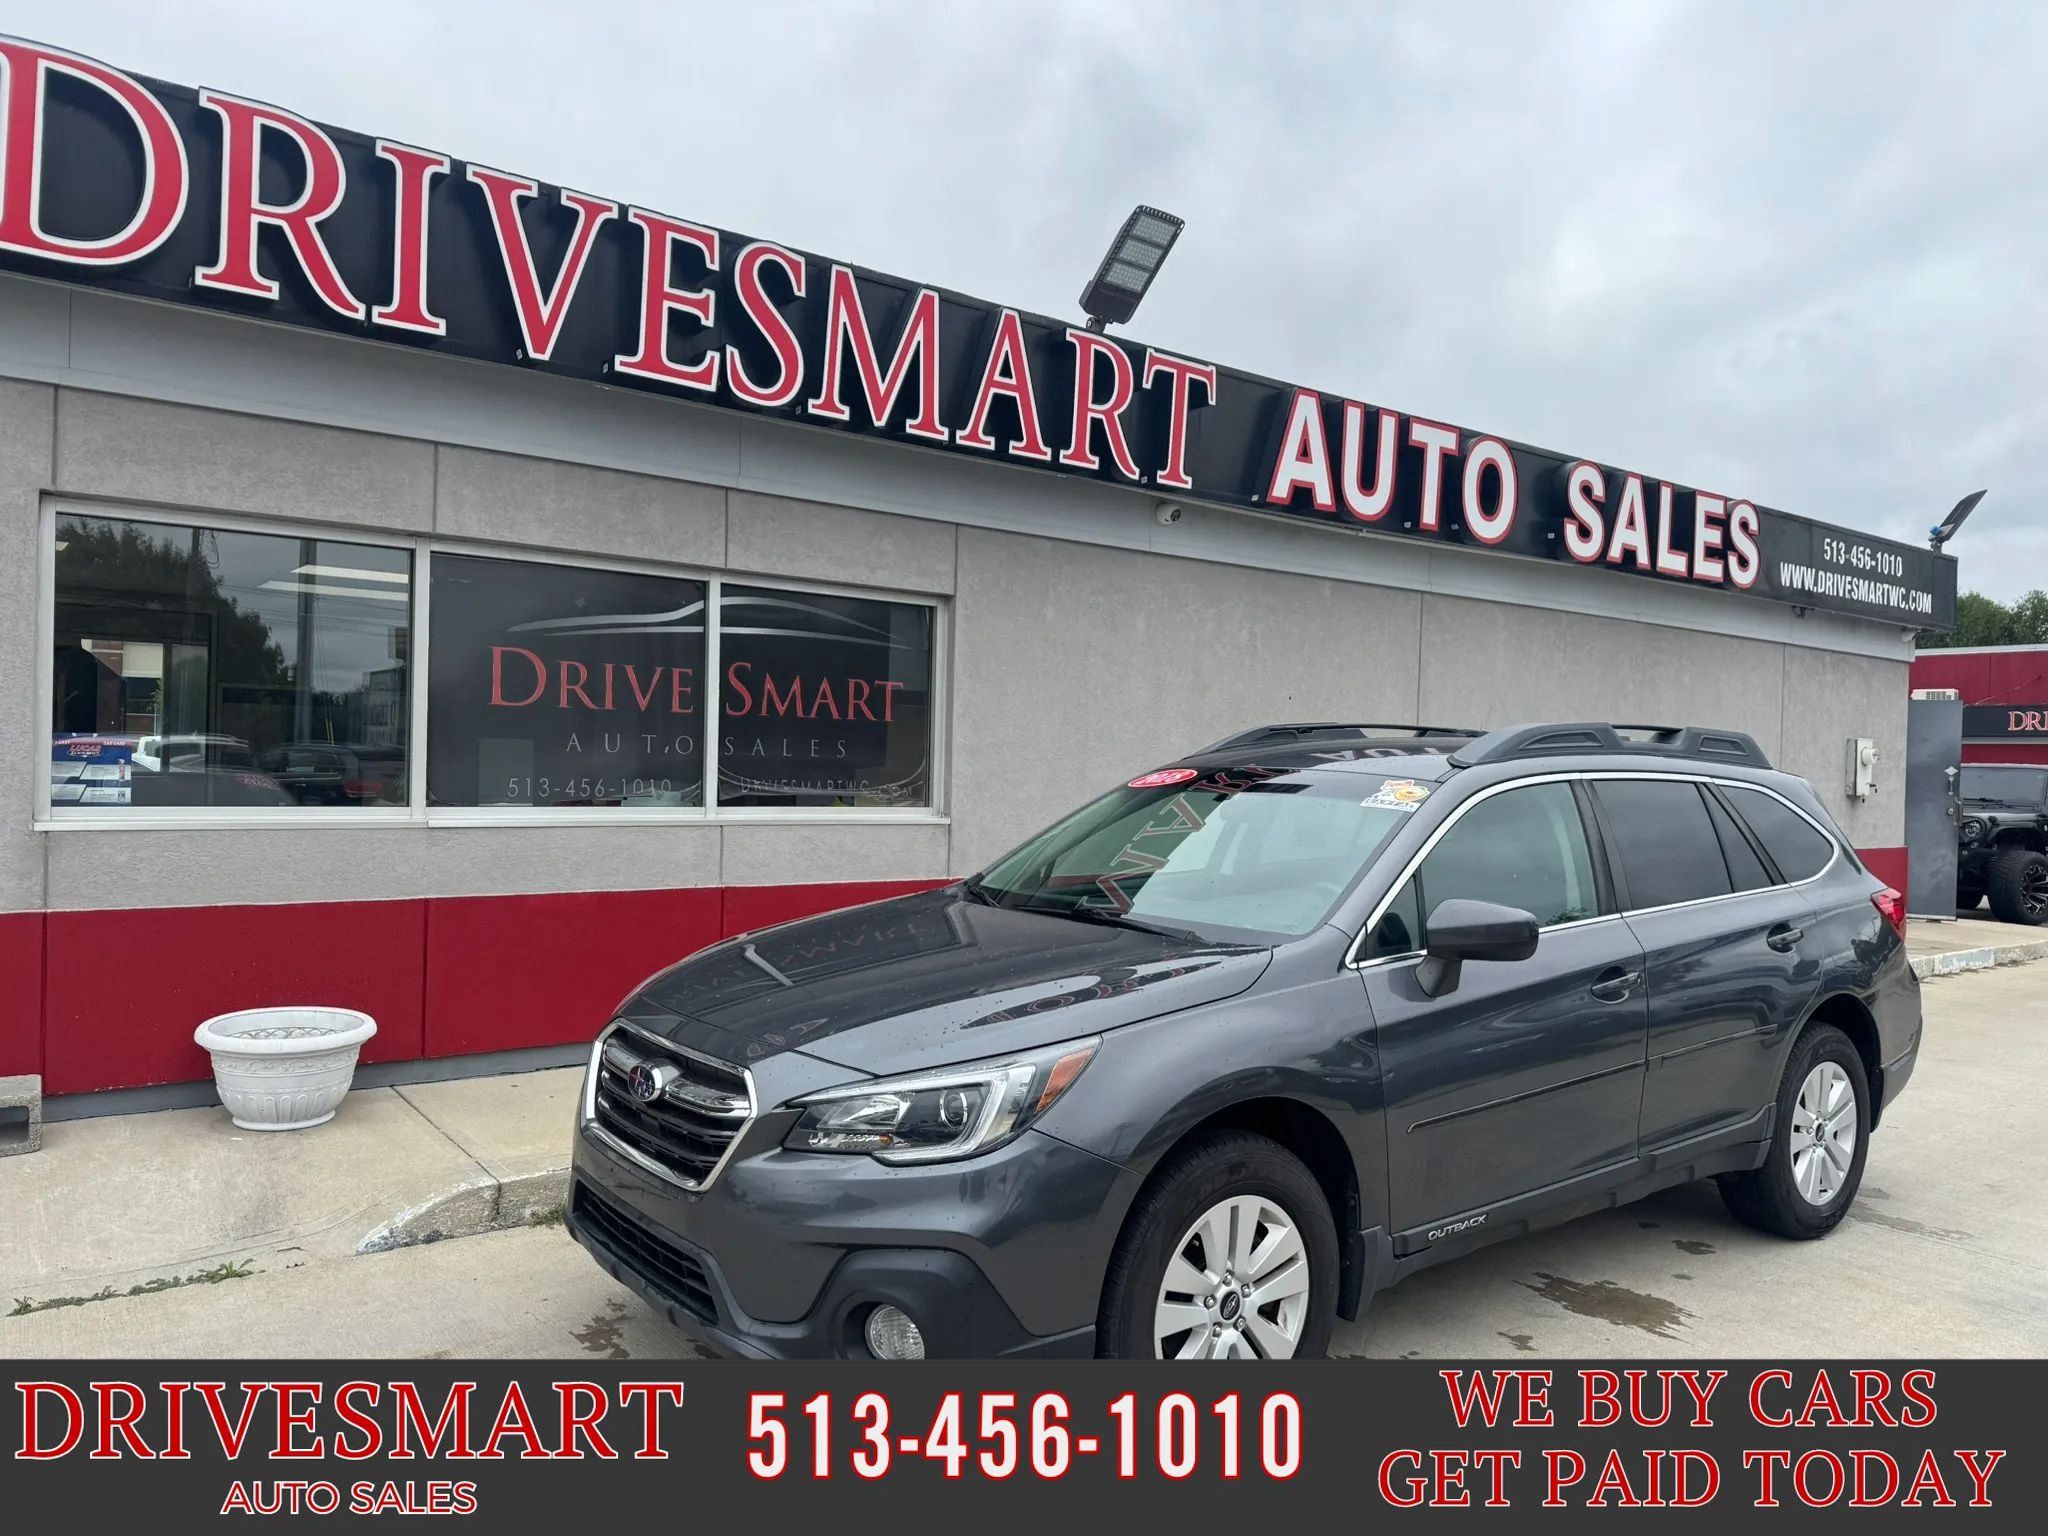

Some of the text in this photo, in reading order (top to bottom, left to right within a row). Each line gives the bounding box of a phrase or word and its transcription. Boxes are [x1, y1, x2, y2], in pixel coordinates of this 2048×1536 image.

[0, 33, 1761, 589] DRIVESMART AUTO SALES
[1823, 537, 1903, 578] 513-456-1010
[1780, 561, 1932, 614] WWW.DRIVESMARTWC.COM
[566, 733, 847, 759] AUTO SALES
[1428, 1214, 1487, 1241] OUTBACK
